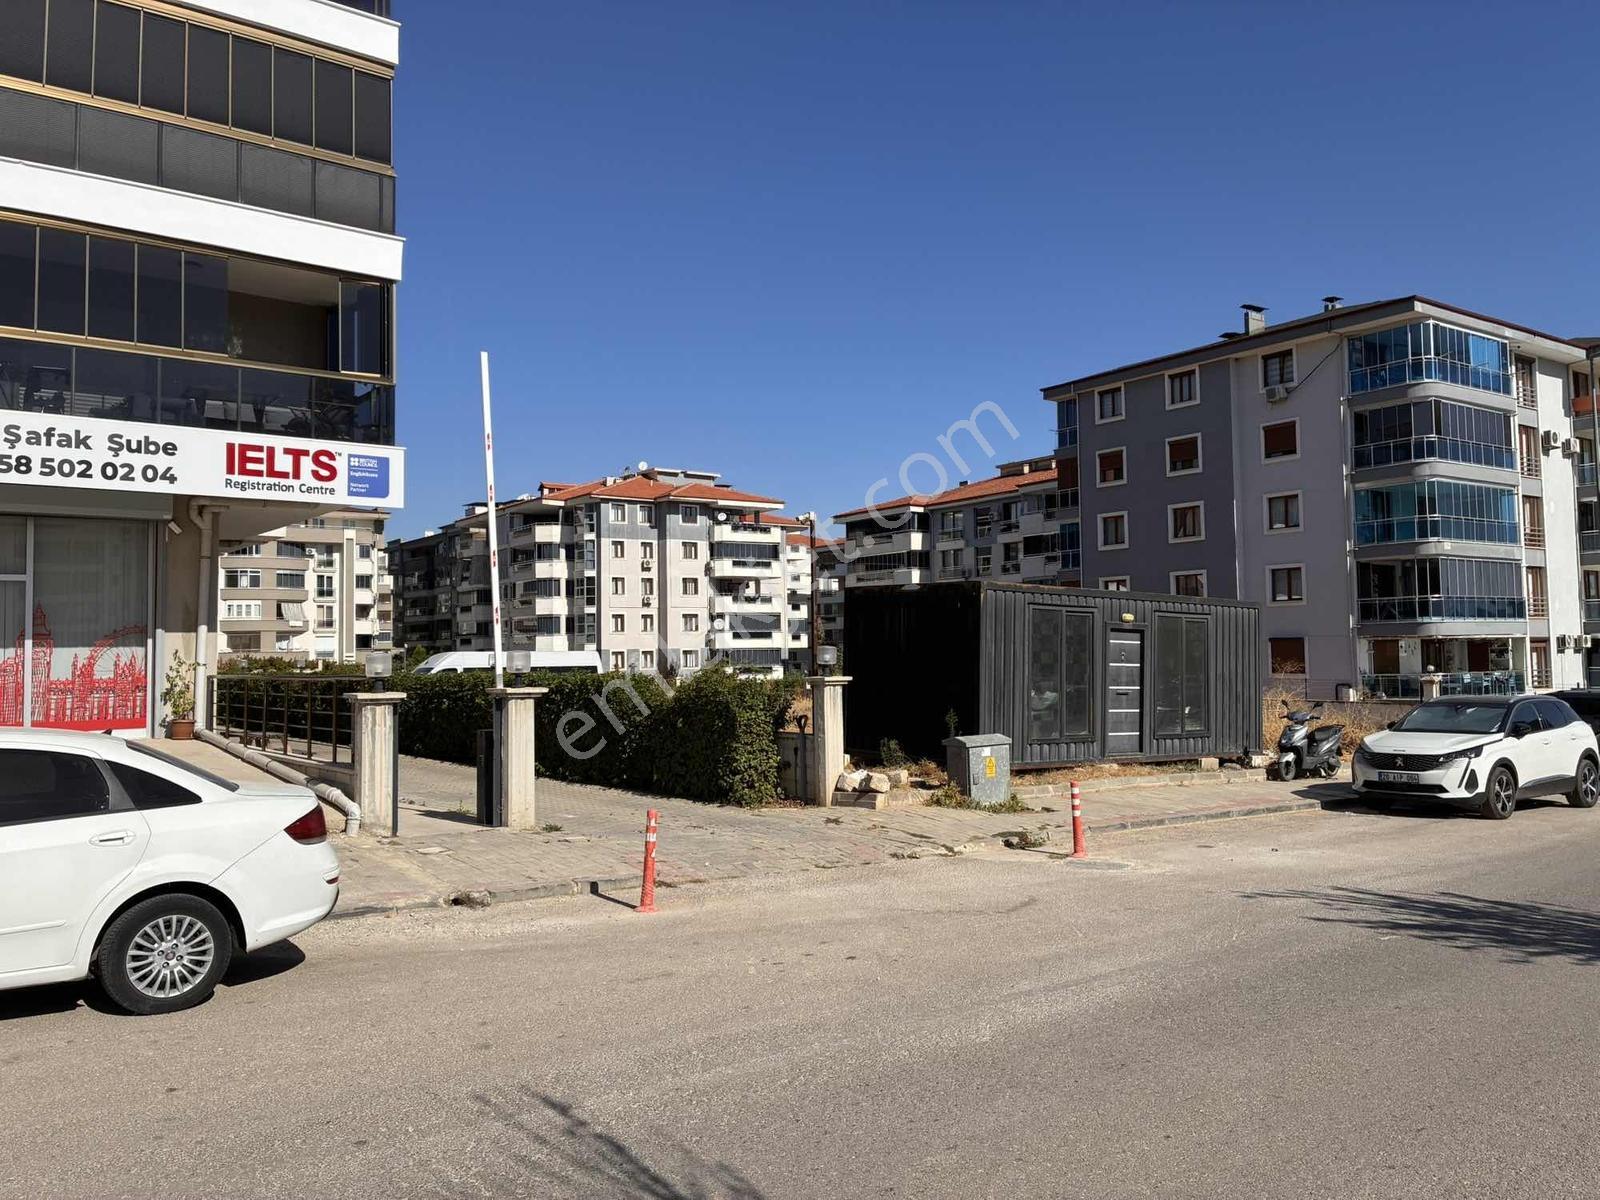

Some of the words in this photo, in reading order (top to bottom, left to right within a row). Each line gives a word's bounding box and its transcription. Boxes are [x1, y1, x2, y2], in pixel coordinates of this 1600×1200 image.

[3, 424, 93, 450] Şafak
[107, 433, 178, 457] Şube
[0, 454, 32, 475] 58
[39, 457, 93, 479] 502
[100, 461, 135, 482] 02
[141, 464, 178, 484] 04
[226, 442, 338, 482] IELTS
[225, 478, 294, 493] Registration
[299, 483, 336, 496] Centre
